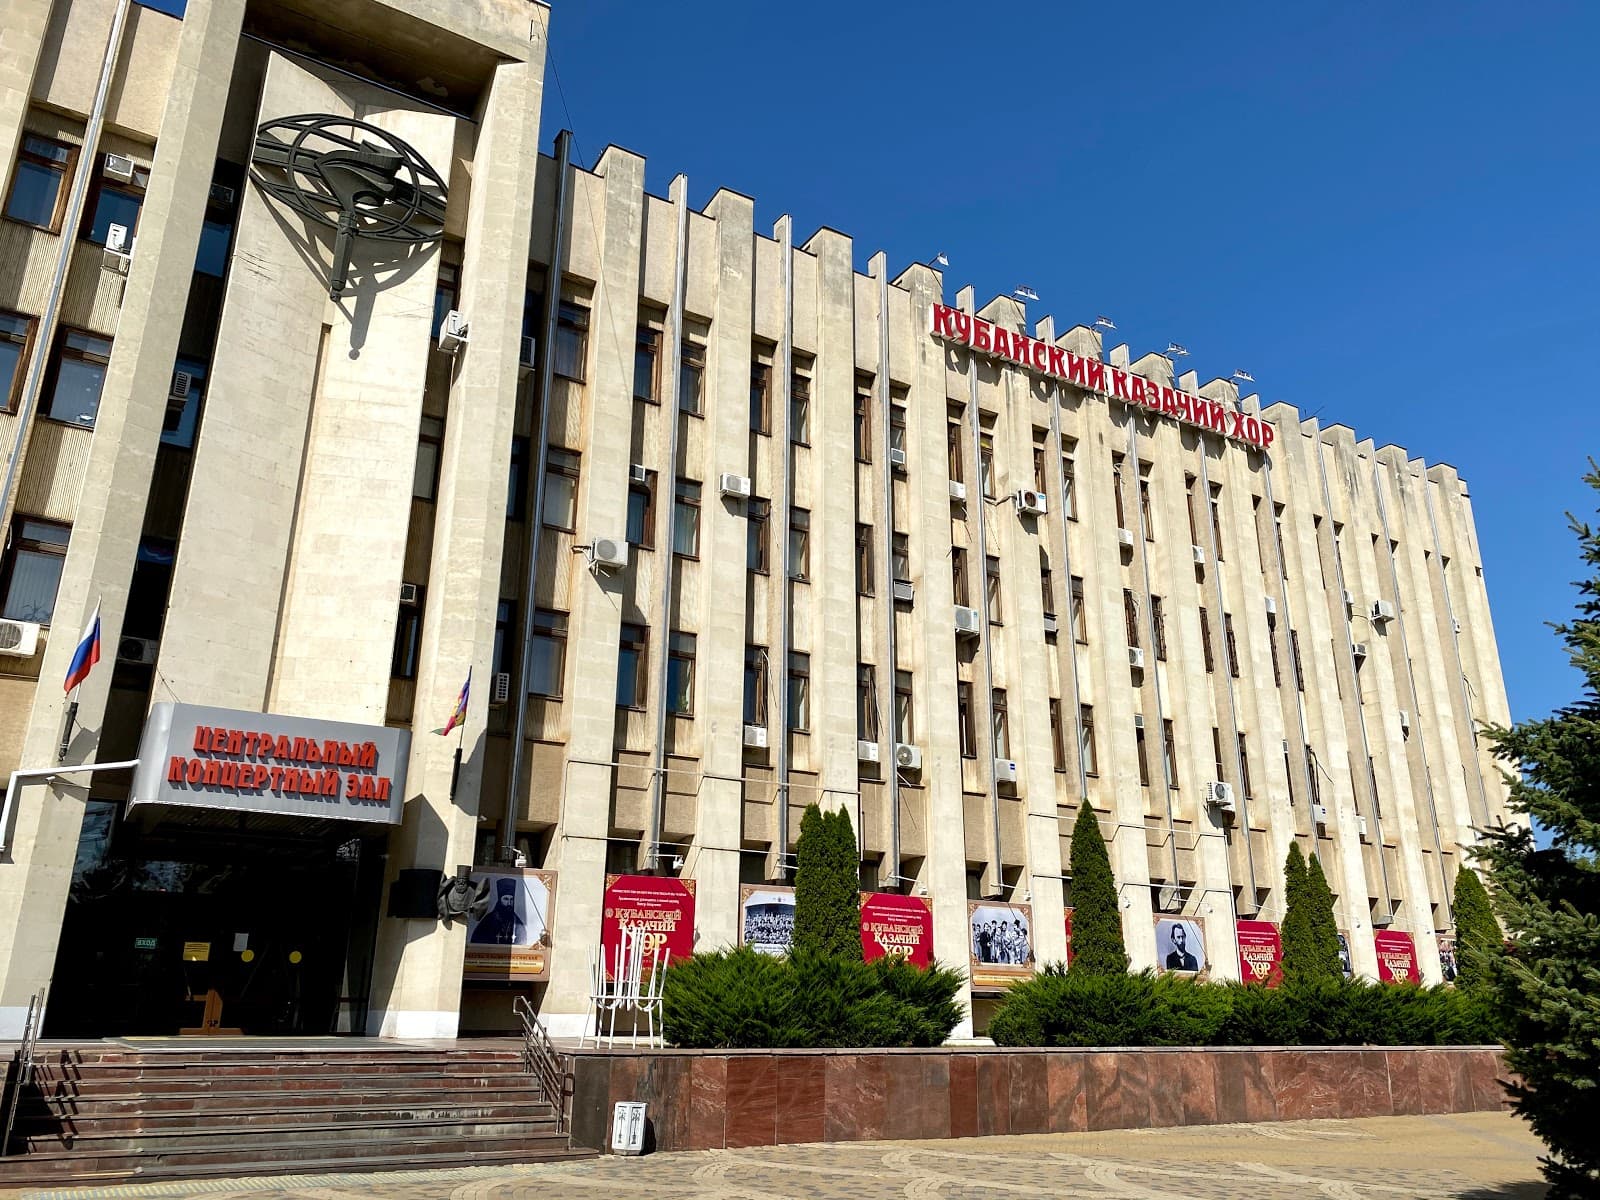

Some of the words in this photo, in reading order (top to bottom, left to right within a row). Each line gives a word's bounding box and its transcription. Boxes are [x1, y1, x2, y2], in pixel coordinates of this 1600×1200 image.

[932, 302, 1106, 392] КУБАНСКИЙ
[1111, 367, 1226, 433] КАЗАЧИЙ
[1230, 409, 1274, 449] ХОР
[193, 725, 377, 768] ЦЕНТРАЛЬНЫЙ
[168, 756, 340, 797] КОНЦЕРТНЫЙ
[345, 773, 391, 800] ЗАЛ
[615, 908, 682, 921] КУБАНСКИЙ
[618, 919, 676, 932] КАЗАЧИЙ
[870, 922, 924, 935] КУБАНСКИЙ
[136, 939, 157, 947] ВХОД
[874, 932, 920, 945] КАЗАЧИЙ
[1250, 961, 1271, 980] ХОР
